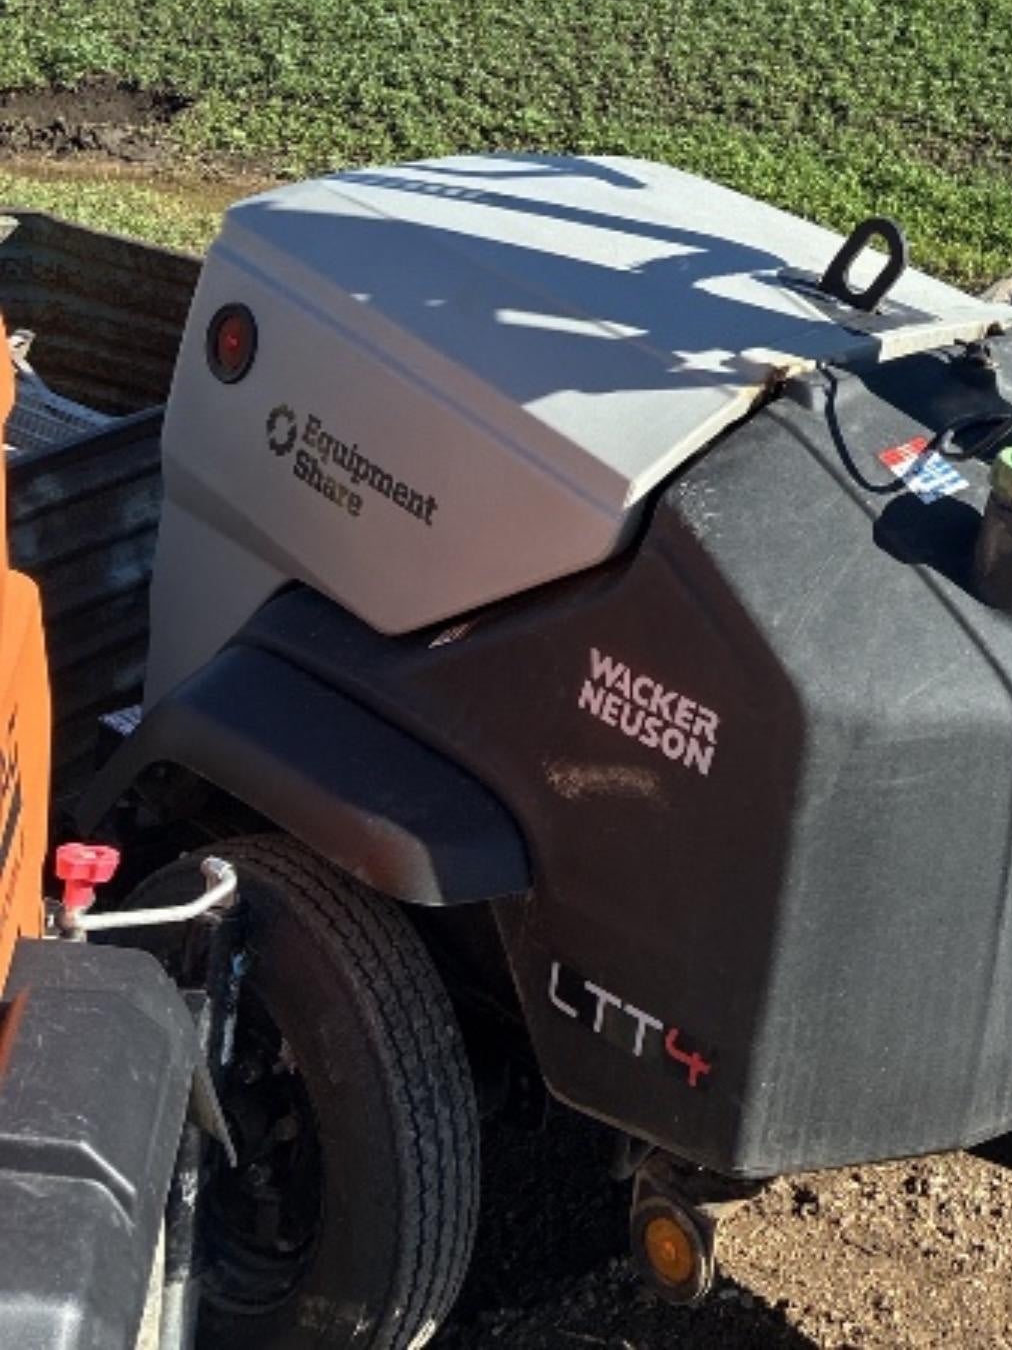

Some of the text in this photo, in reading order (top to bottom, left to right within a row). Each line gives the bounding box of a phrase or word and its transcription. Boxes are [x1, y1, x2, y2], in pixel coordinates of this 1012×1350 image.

[293, 449, 364, 517] Share
[302, 413, 438, 526] Equipment
[578, 680, 715, 776] NEUSON
[590, 647, 720, 744] WACKER
[549, 961, 711, 1087] LTT4
